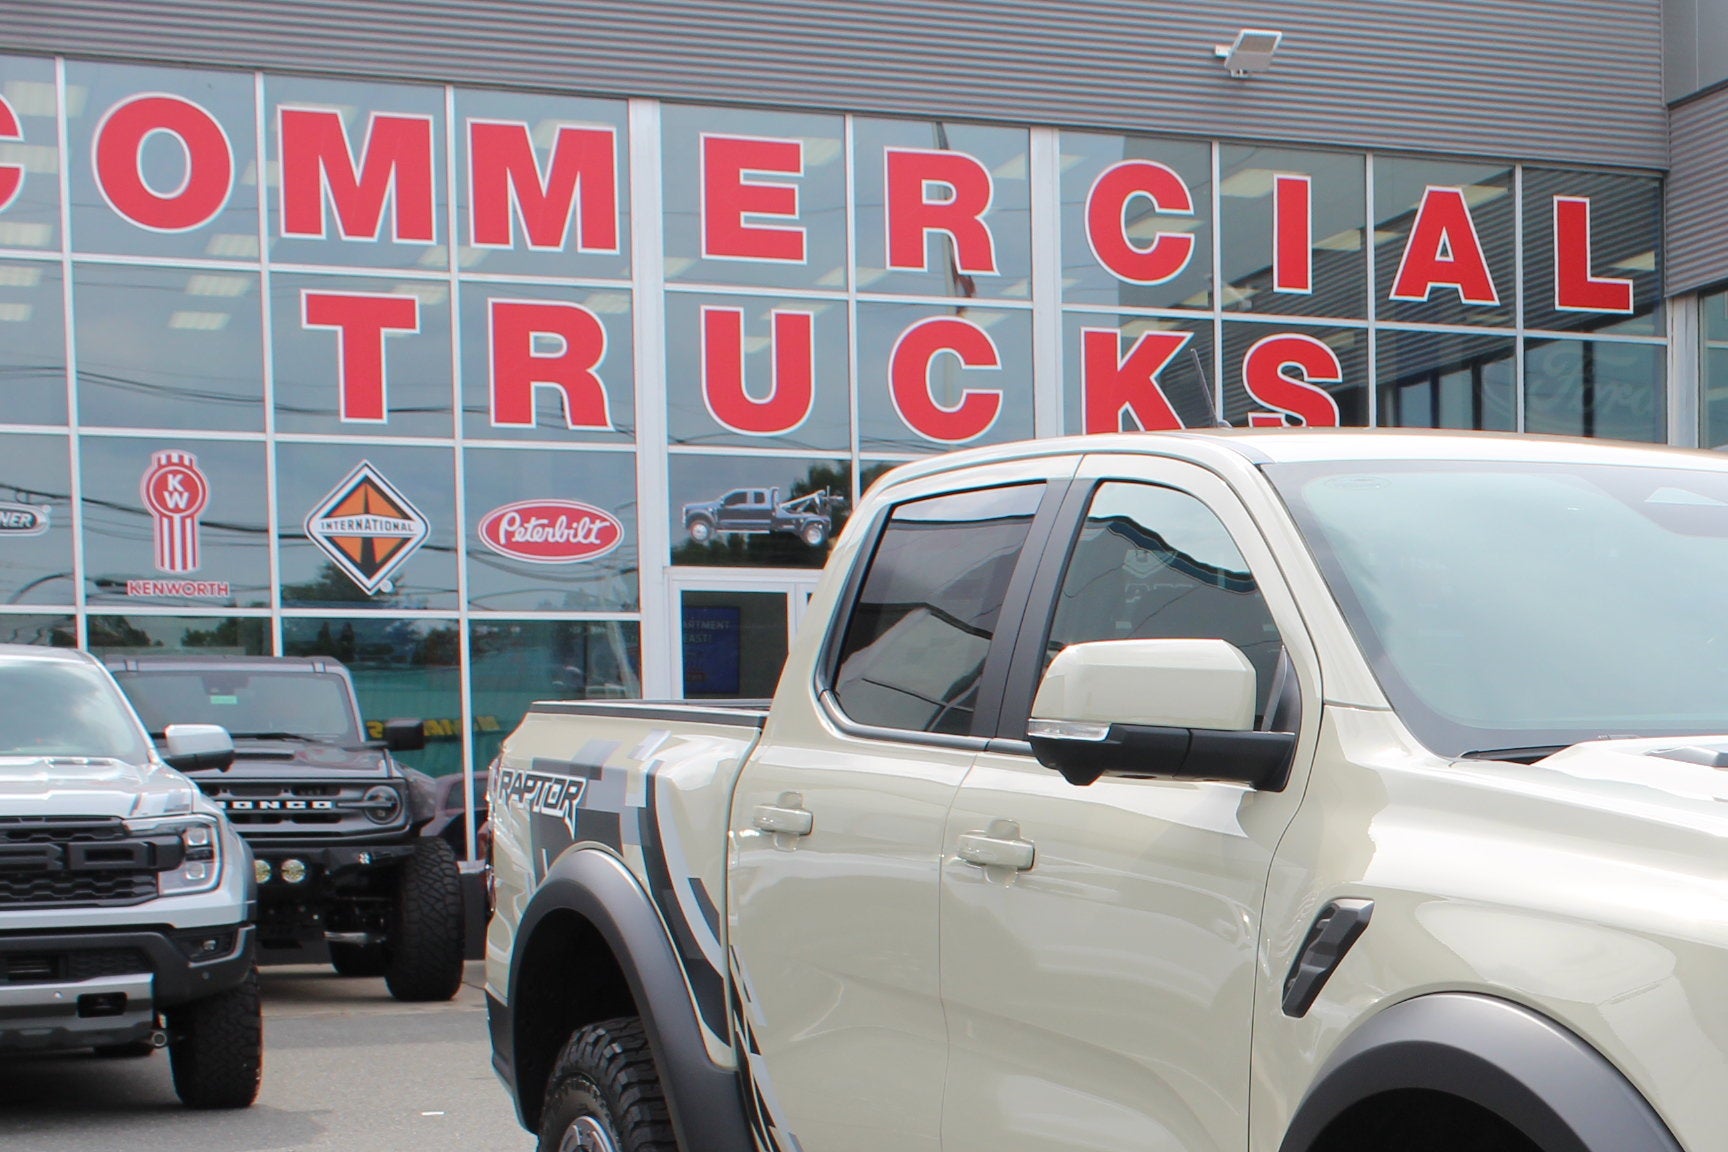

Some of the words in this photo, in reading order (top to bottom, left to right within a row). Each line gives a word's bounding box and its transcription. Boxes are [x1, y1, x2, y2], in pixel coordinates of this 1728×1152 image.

[0, 92, 1634, 315] OMMERCIAL
[301, 288, 1342, 443] TRUCKS
[320, 516, 415, 533] INTERNATIONAL
[499, 511, 611, 545] Peterbilt
[126, 580, 229, 597] KENWORTH
[499, 766, 588, 841] RAPTOR
